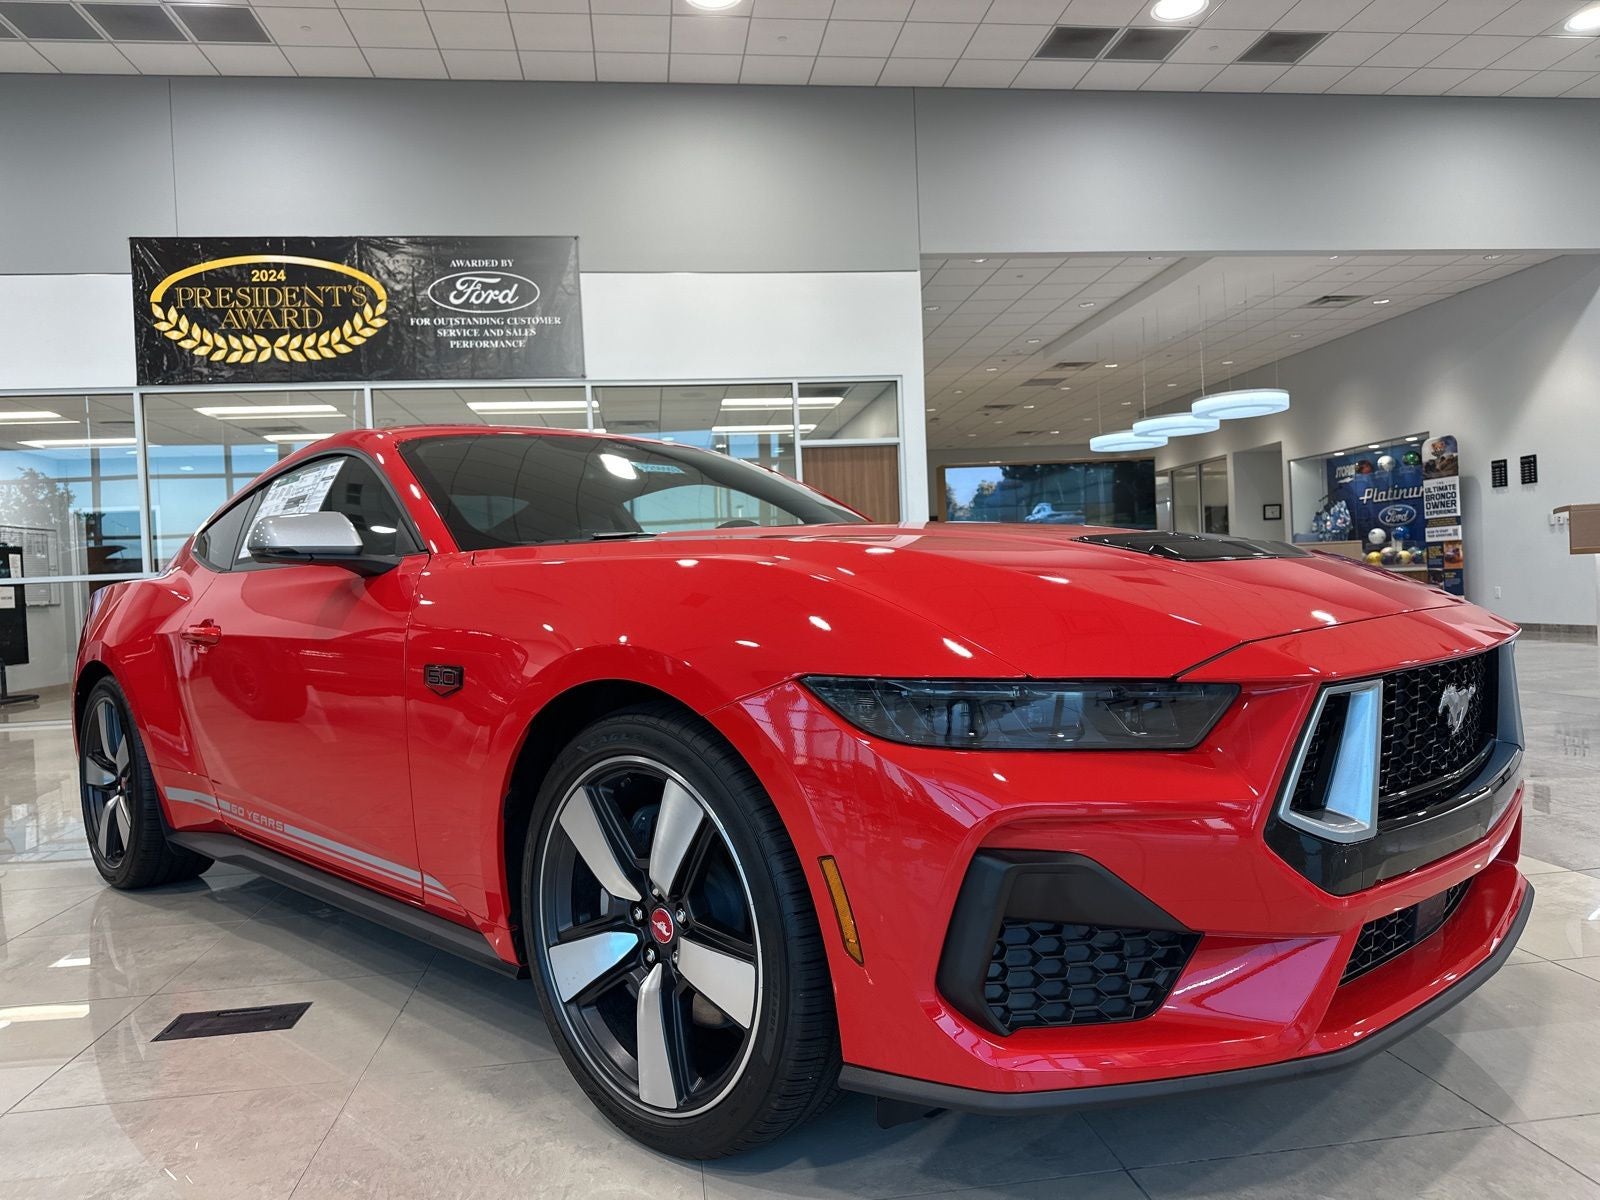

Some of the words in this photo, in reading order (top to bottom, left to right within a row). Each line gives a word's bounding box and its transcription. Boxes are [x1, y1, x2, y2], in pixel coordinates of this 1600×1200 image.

[450, 259, 499, 268] AWARDED
[500, 259, 514, 268] BY
[251, 269, 287, 282] 2024
[449, 276, 520, 305] Ford
[174, 285, 368, 309] PRESIDENT'S
[218, 307, 324, 330] AWARD
[410, 317, 431, 326] FOR
[433, 317, 504, 326] OUTSTANDING
[506, 316, 562, 326] CUSTOMER
[436, 328, 480, 337] SERVICE
[482, 328, 504, 337] AND
[505, 327, 537, 337] SALES
[450, 339, 526, 349] PERFORMANCE
[1424, 483, 1457, 494] ULTIMATE
[1425, 491, 1457, 502] BRONCO
[1425, 499, 1457, 510] OWNER
[1385, 507, 1409, 523] Ford
[230, 804, 245, 817] 60
[246, 809, 284, 831] YEARS
